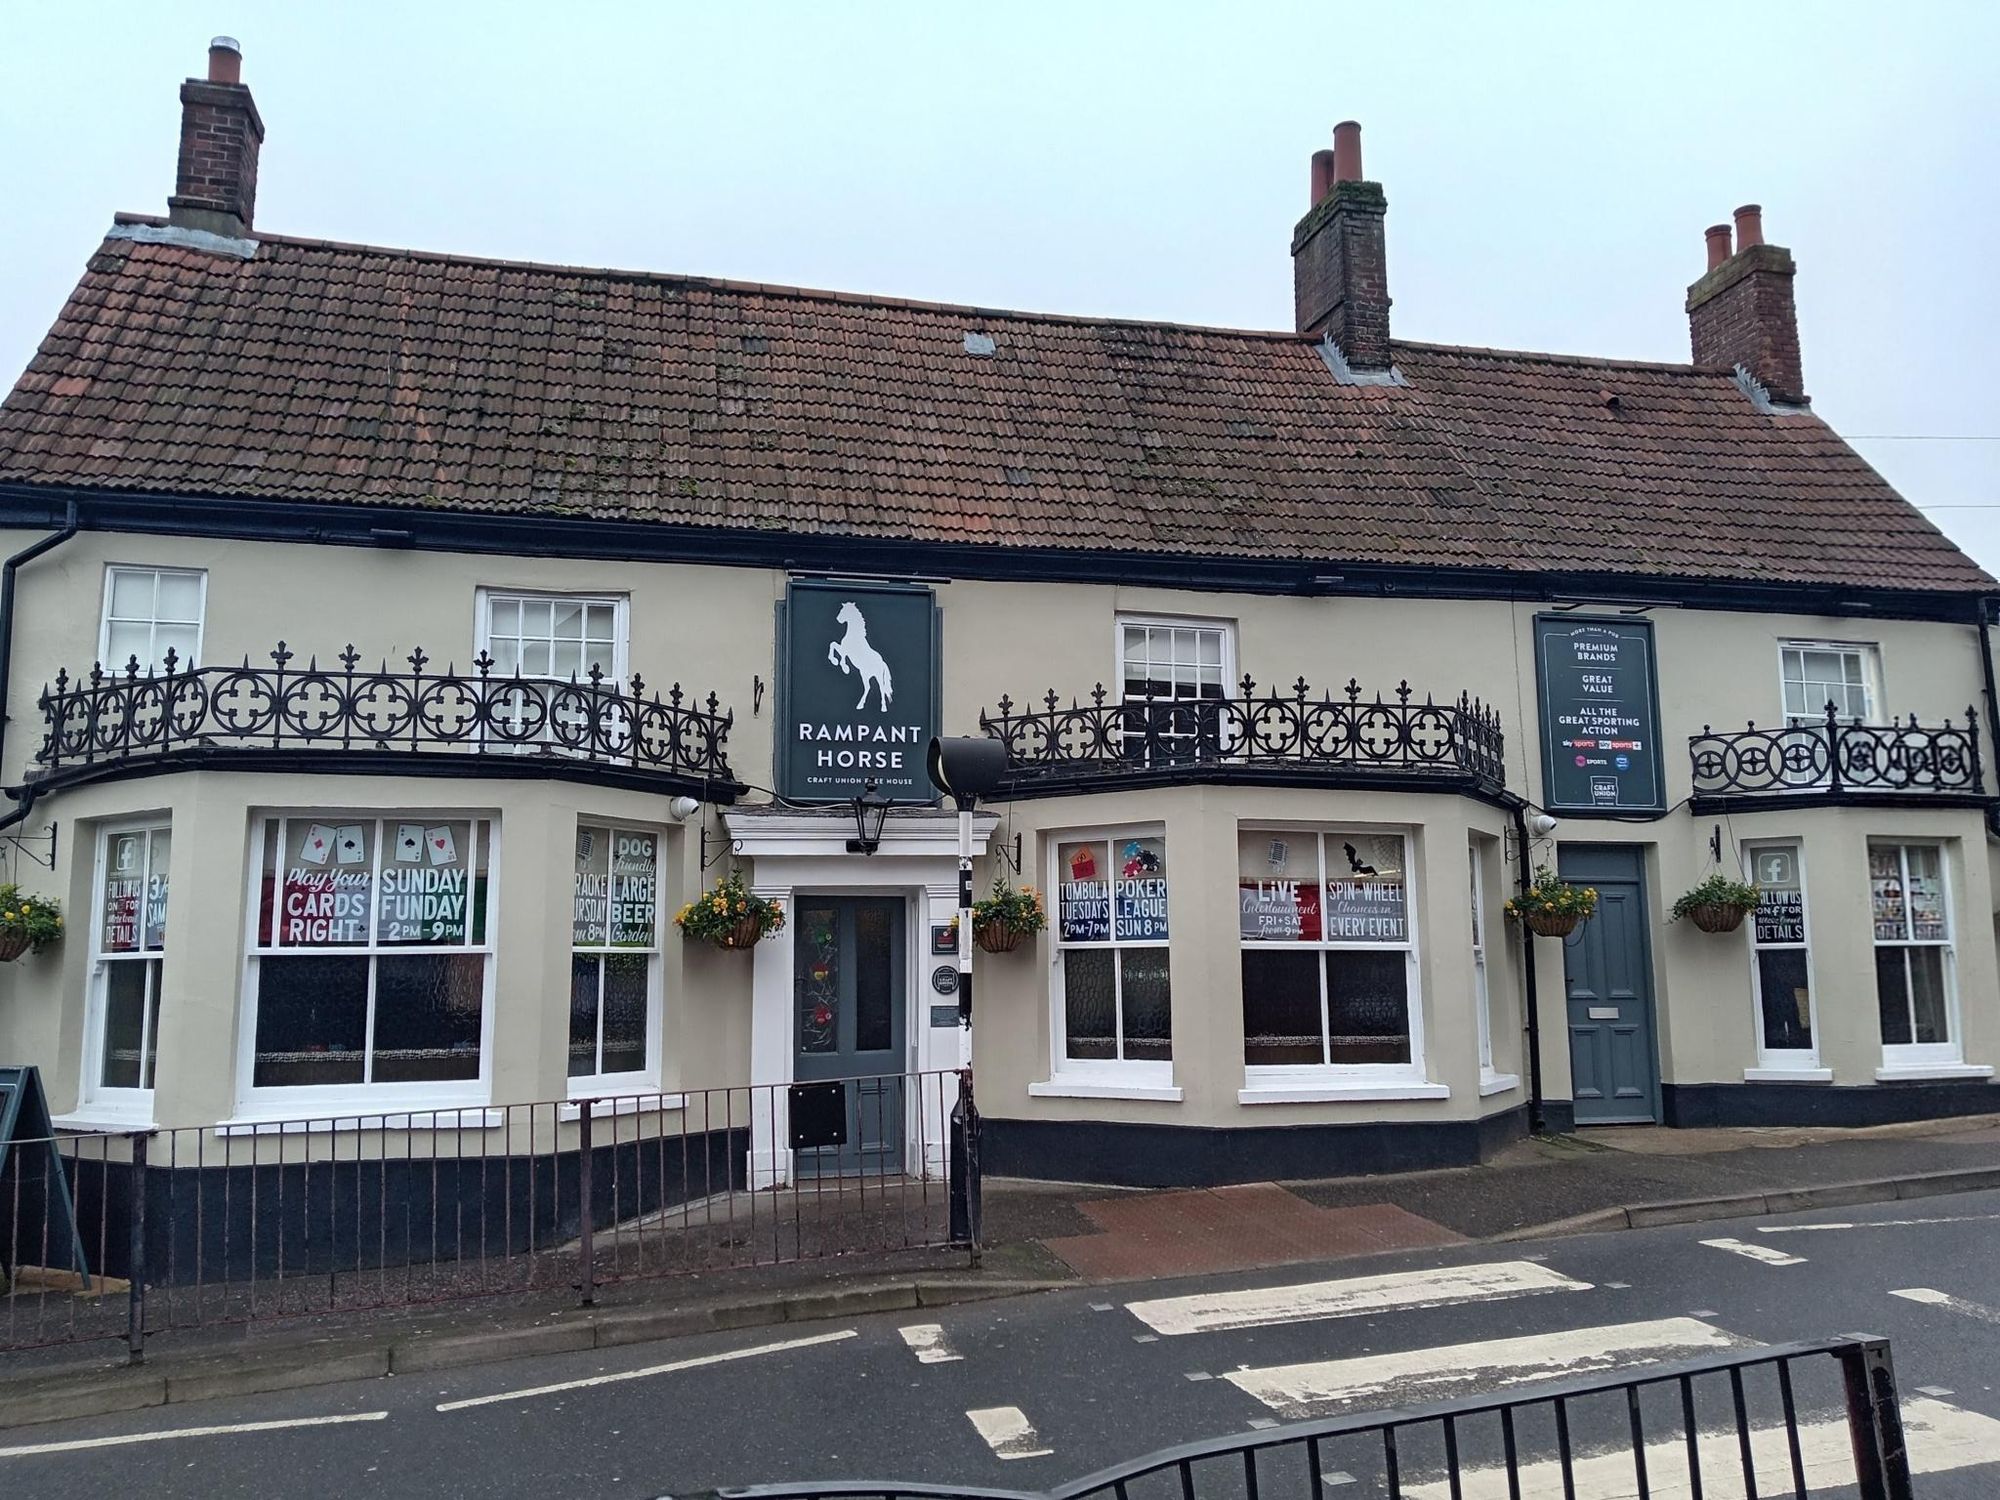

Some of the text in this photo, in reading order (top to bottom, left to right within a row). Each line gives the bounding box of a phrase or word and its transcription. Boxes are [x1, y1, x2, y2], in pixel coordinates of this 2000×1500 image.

[1573, 642, 1618, 652] PREMIUM
[1577, 652, 1616, 662] BRANDS
[1582, 675, 1612, 684] GREAT
[1582, 684, 1613, 693] VALUE
[1558, 715, 1640, 727] GREAT SPORTING
[1579, 707, 1617, 716] ALL THE
[799, 723, 922, 743] RAMPANT
[1581, 726, 1618, 735] ACTION
[818, 750, 903, 768] HORSE
[807, 776, 833, 784] CRAFT
[864, 777, 884, 785] FEE
[618, 838, 652, 857] DOG
[613, 854, 656, 877] friendly
[108, 880, 132, 899] FOLLOW
[286, 867, 370, 893] Play Your
[382, 868, 465, 894] SUNDAY
[612, 876, 655, 903] LARGE
[1115, 879, 1167, 898] POKER
[1060, 882, 1108, 901] TOMBOLA
[1760, 891, 1802, 905] OLLOW US
[107, 900, 140, 911] ON FOR
[287, 893, 365, 917] CARDS
[380, 895, 465, 921] FUNDAY
[611, 904, 655, 924] BEER
[1060, 901, 1109, 920] TUESDAYS
[1115, 898, 1167, 918] LEAGUE
[1242, 898, 1318, 915] Entertainment
[1337, 900, 1378, 914] Chances
[1756, 906, 1771, 914] ON
[1781, 906, 1802, 914] FOR
[147, 903, 166, 928] SAM
[105, 925, 138, 944] DETAILS
[289, 919, 359, 942] RIGHT
[611, 923, 653, 943] Garden
[1116, 919, 1142, 936] SUN
[1330, 917, 1404, 937] EVERY EVENT
[1757, 924, 1803, 939] DETAILS
